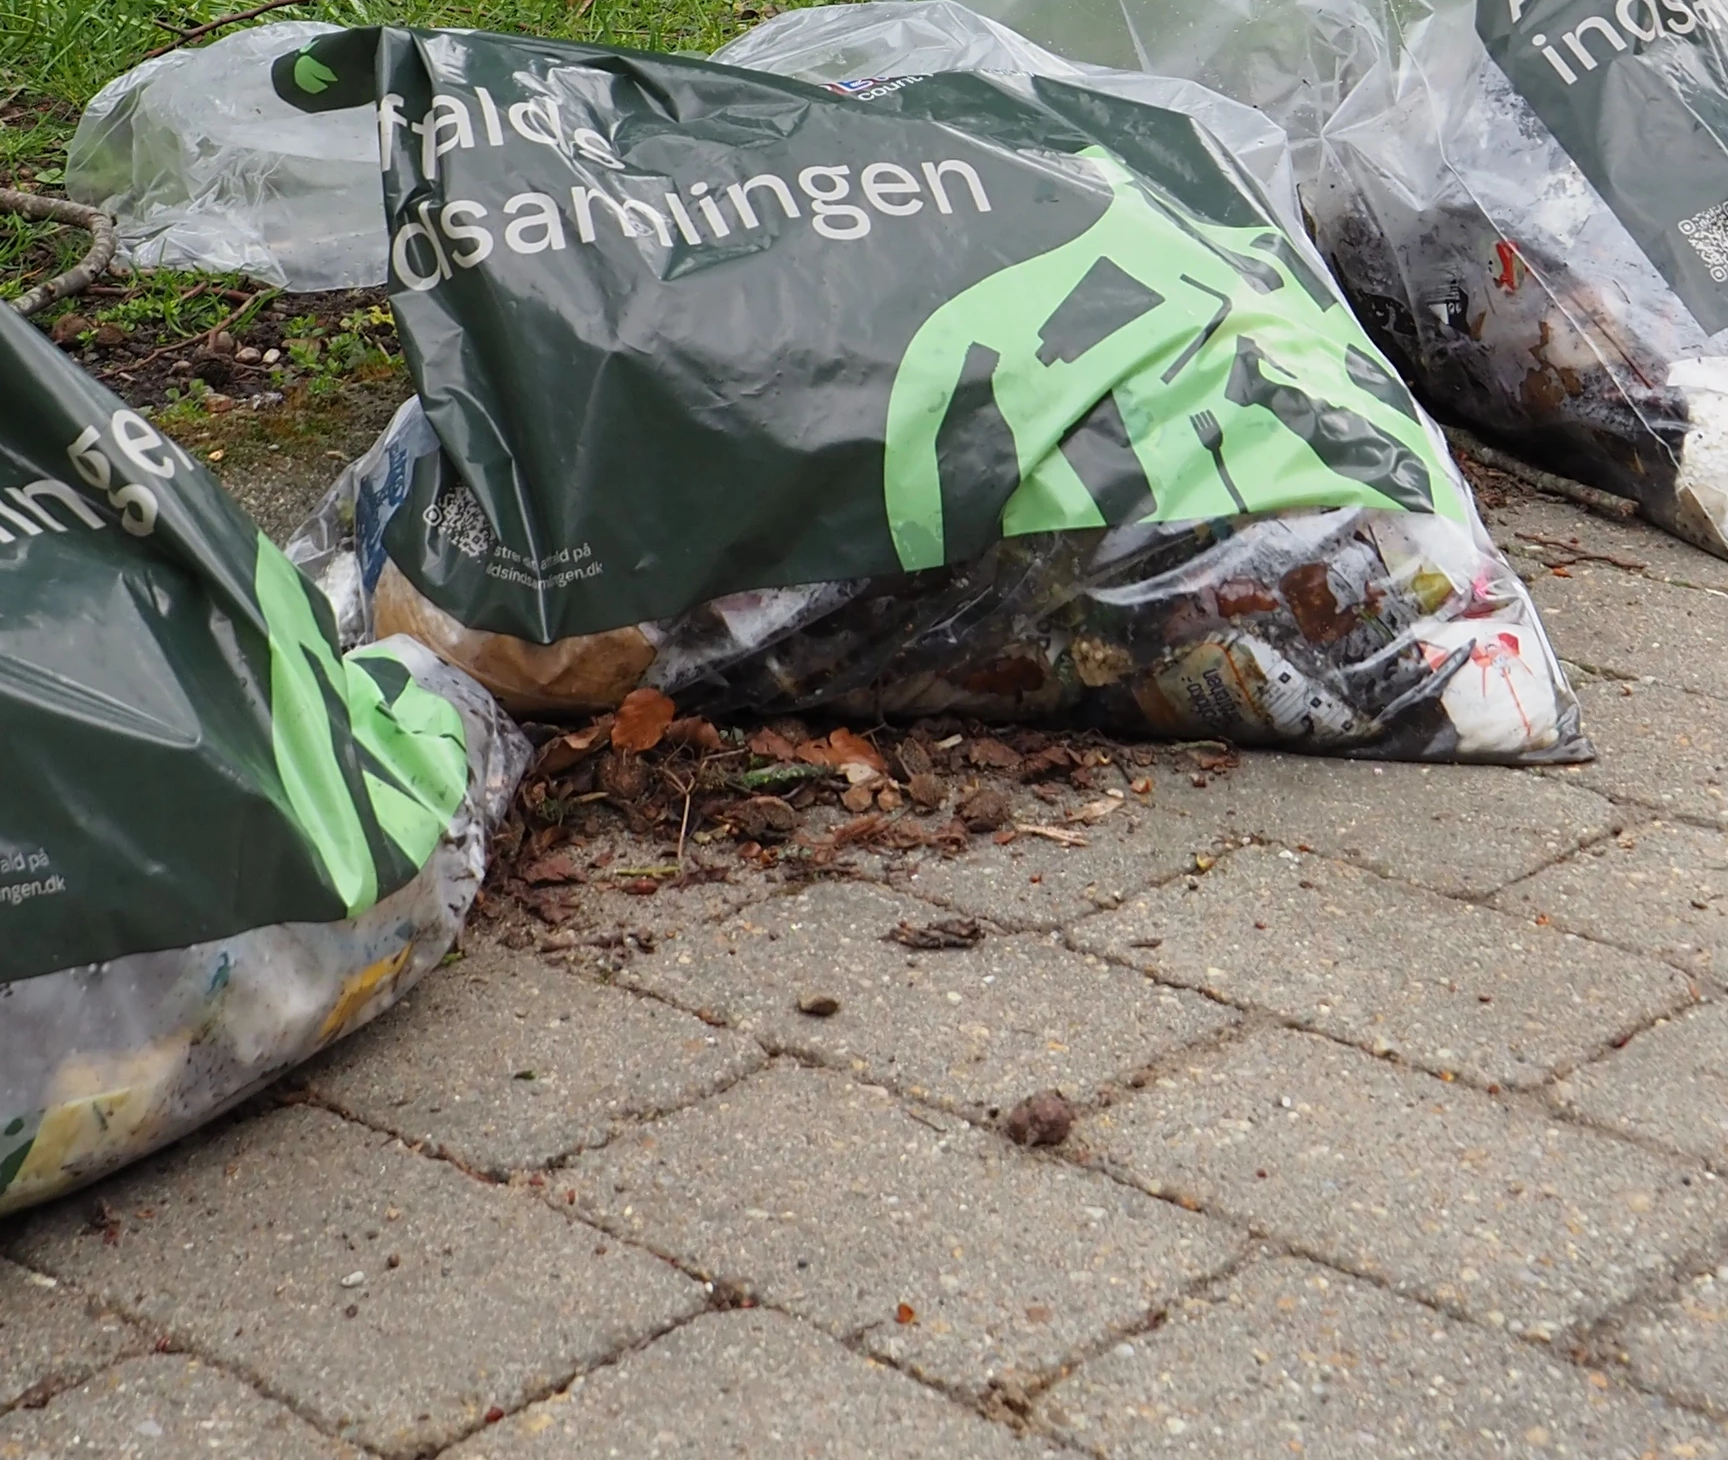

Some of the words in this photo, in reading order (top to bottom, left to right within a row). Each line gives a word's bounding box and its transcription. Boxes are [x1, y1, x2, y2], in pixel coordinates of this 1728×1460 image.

[378, 85, 627, 180] ffalds
[392, 156, 991, 292] dsamlingen
[573, 542, 592, 563] på
[28, 847, 50, 873] på
